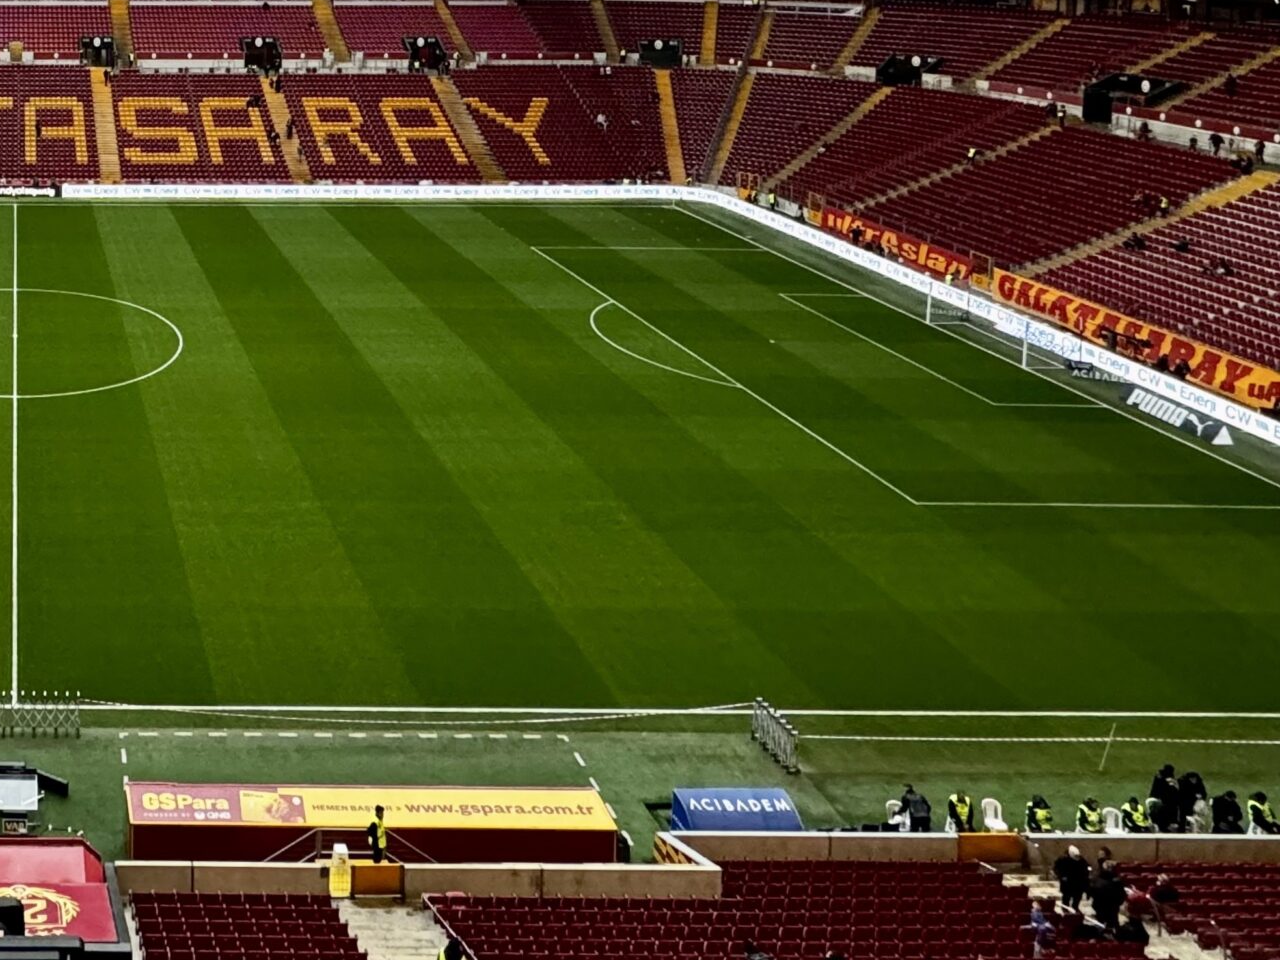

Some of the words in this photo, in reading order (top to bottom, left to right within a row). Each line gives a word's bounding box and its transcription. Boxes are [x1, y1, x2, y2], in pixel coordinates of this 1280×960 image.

[1071, 368, 1132, 384] ACIBADE
[1137, 368, 1161, 388] CW
[1225, 405, 1251, 426] CW
[1126, 388, 1191, 428] PUMA
[142, 792, 230, 811] GSPara
[689, 797, 792, 812] ACIBADEM
[206, 811, 231, 821] QNB
[312, 804, 348, 812] HEMEN
[351, 804, 393, 815] BAŞR
[405, 803, 595, 817] www.gspara.com.tr
